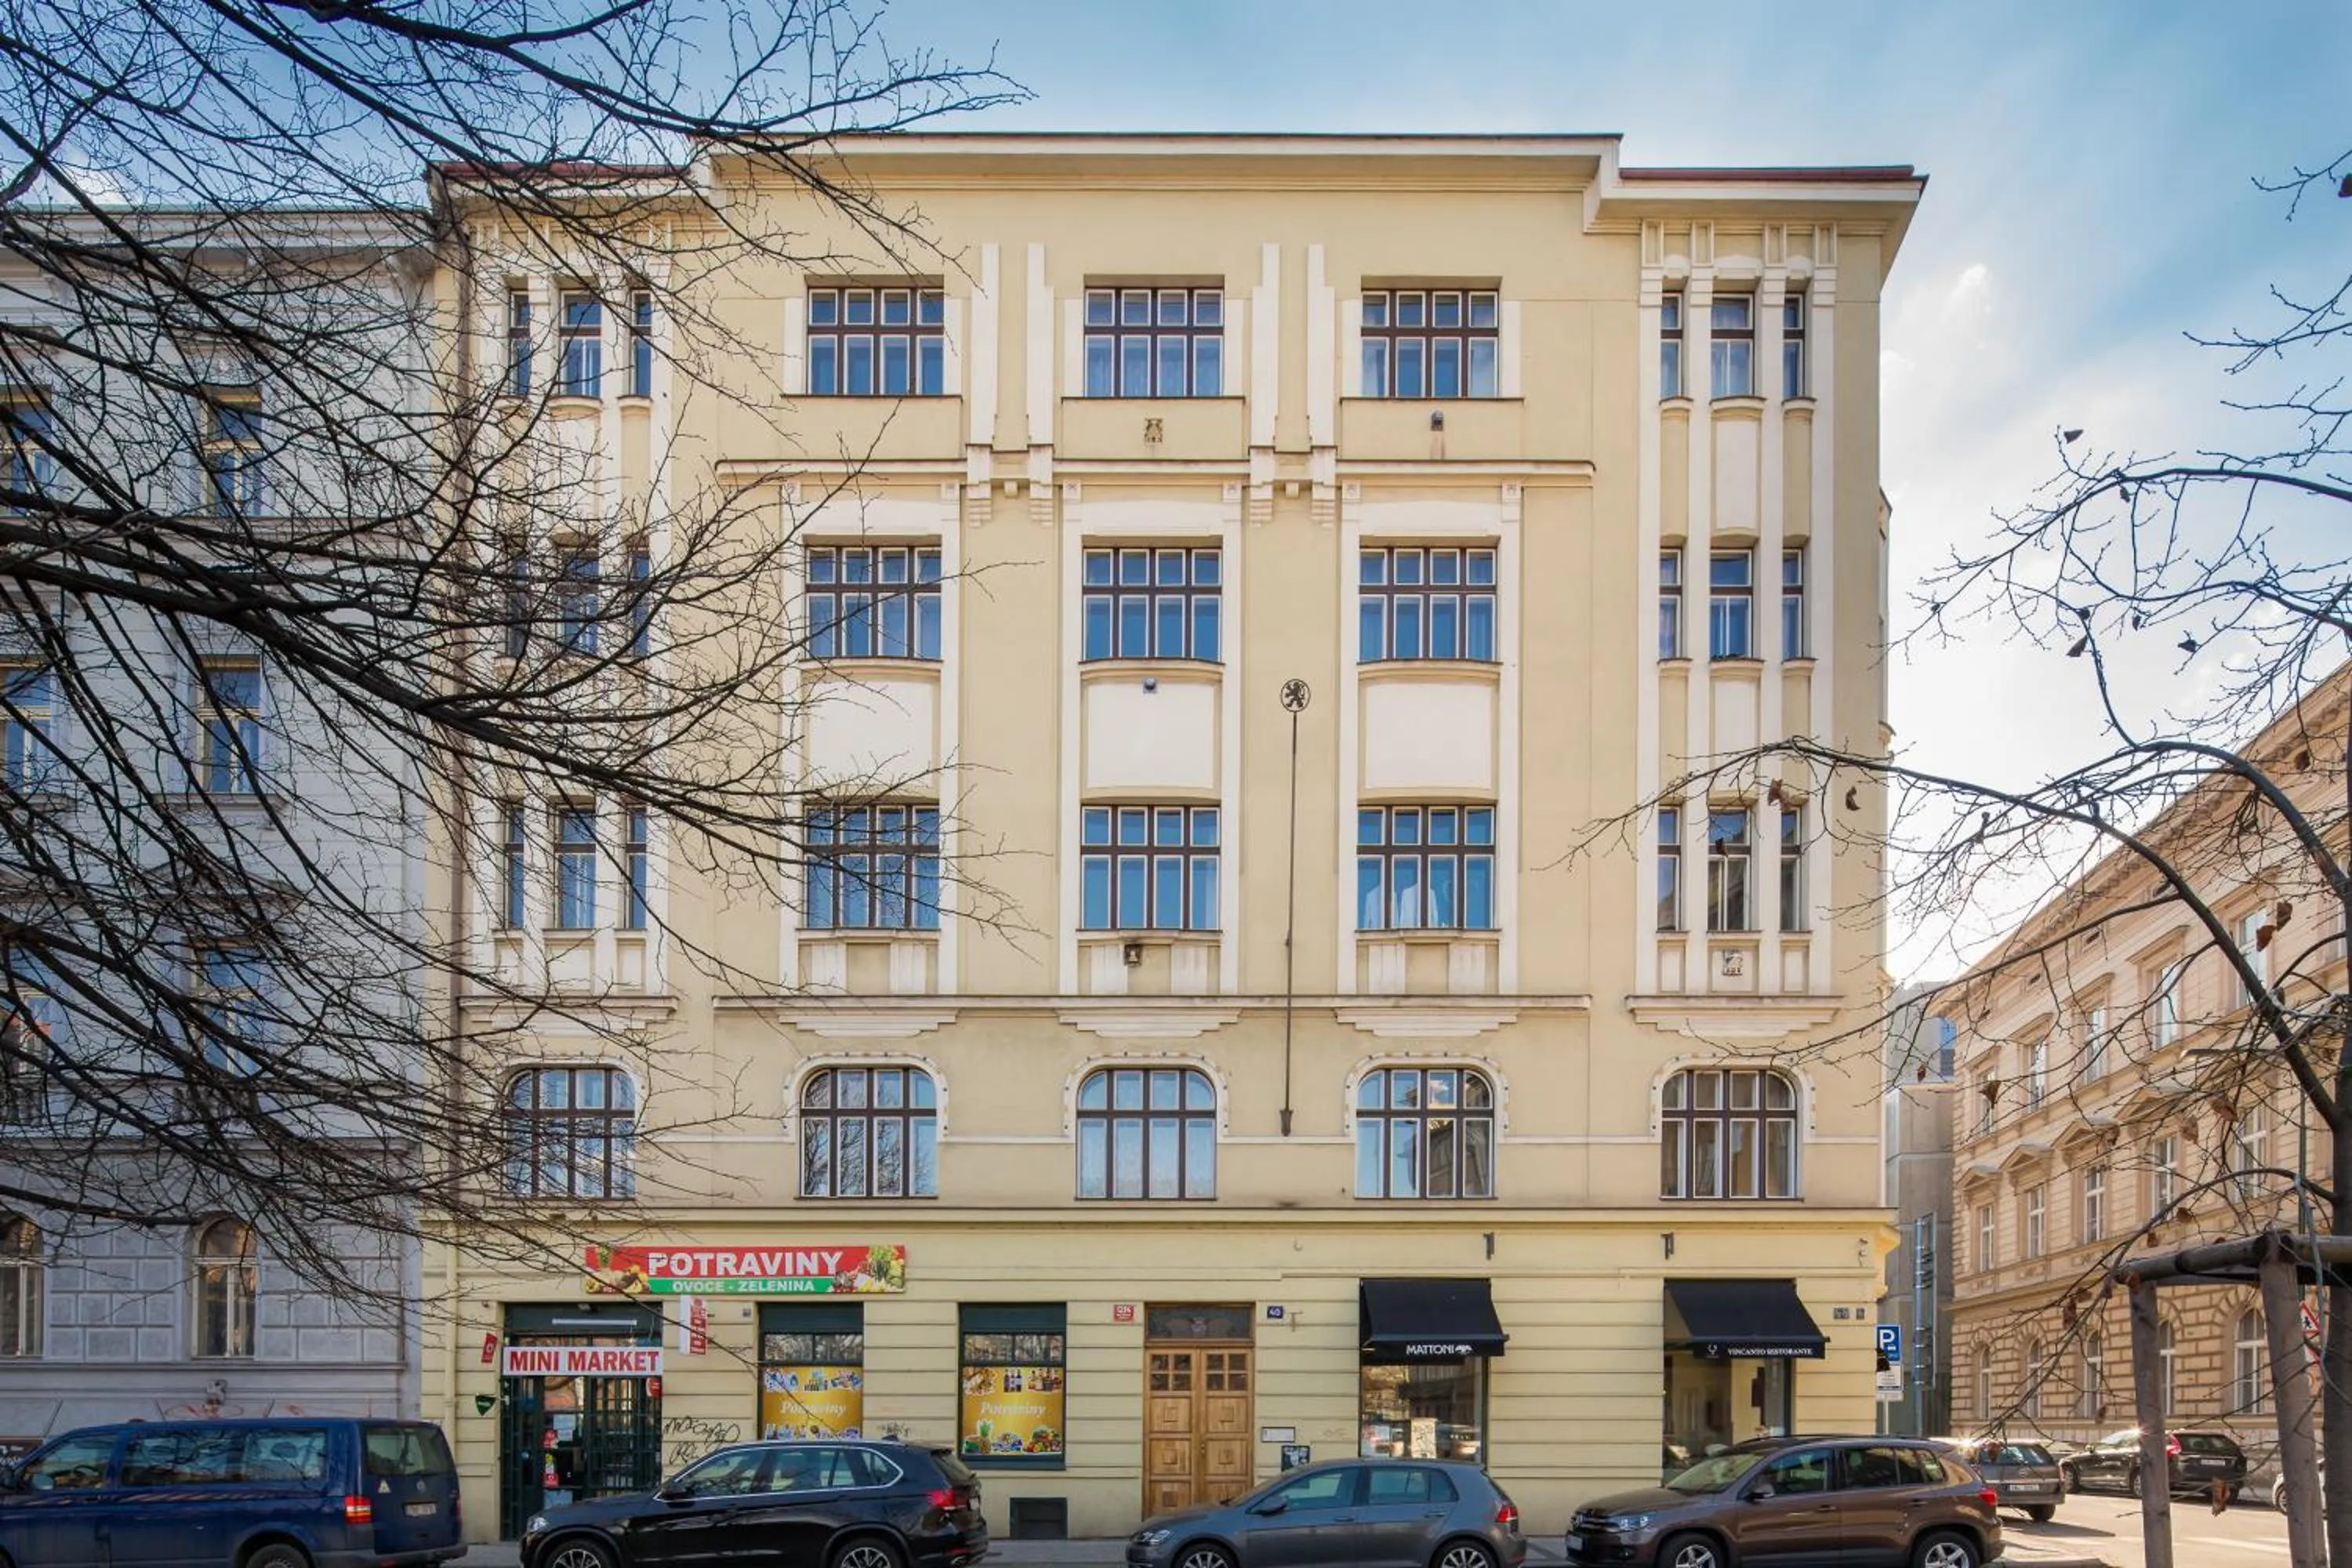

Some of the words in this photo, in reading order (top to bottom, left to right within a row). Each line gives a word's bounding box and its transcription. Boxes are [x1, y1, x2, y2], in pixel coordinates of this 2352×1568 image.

[648, 1252, 843, 1276] POTRAVINY
[673, 1281, 724, 1292] OVOCE
[738, 1280, 814, 1291] ZELENINA
[1406, 1345, 1454, 1354] MATTONI
[1880, 1330, 1895, 1350] P
[510, 1351, 558, 1371] MINI
[568, 1351, 659, 1371] MARKET
